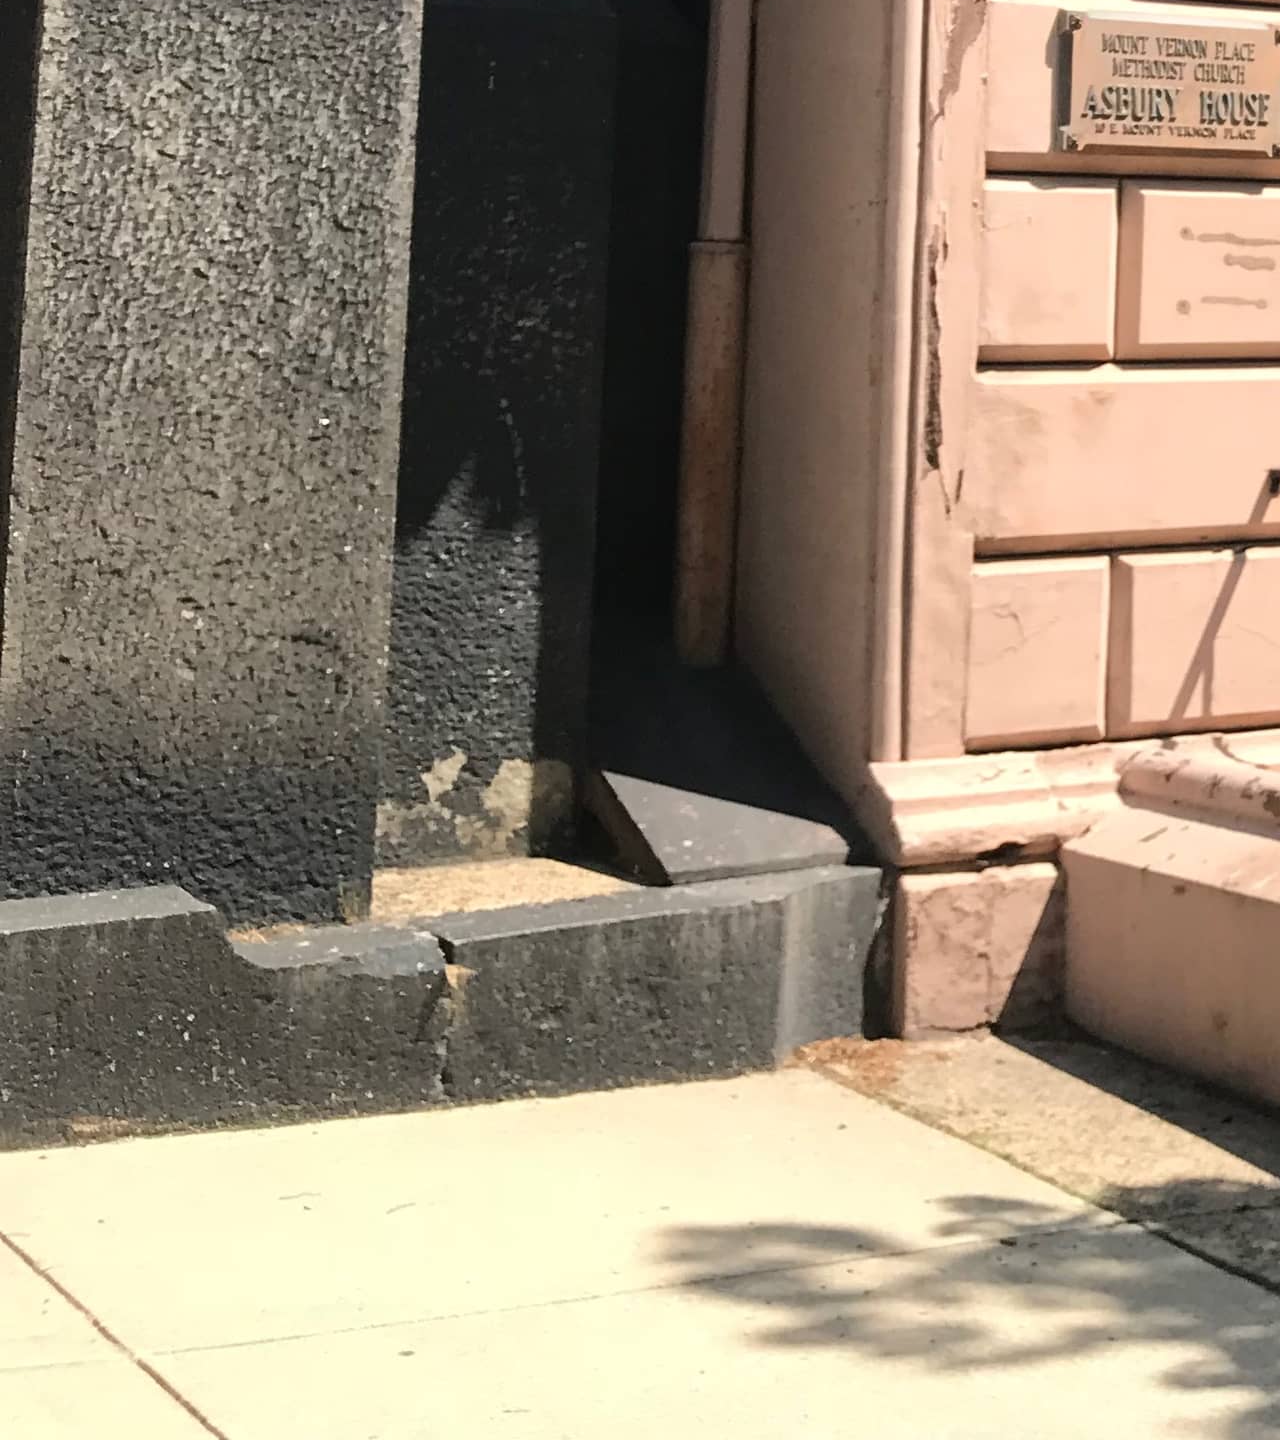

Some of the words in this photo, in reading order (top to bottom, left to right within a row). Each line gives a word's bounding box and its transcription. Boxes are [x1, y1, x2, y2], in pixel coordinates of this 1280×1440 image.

[1101, 33, 1149, 56] MOUNT
[1156, 36, 1208, 60] VERNON
[1214, 41, 1256, 62] PLACE
[1112, 58, 1187, 80] METHODIST
[1193, 62, 1246, 85] CHURCH
[1080, 84, 1181, 123] ASBURY
[1199, 89, 1271, 127] HOUSE
